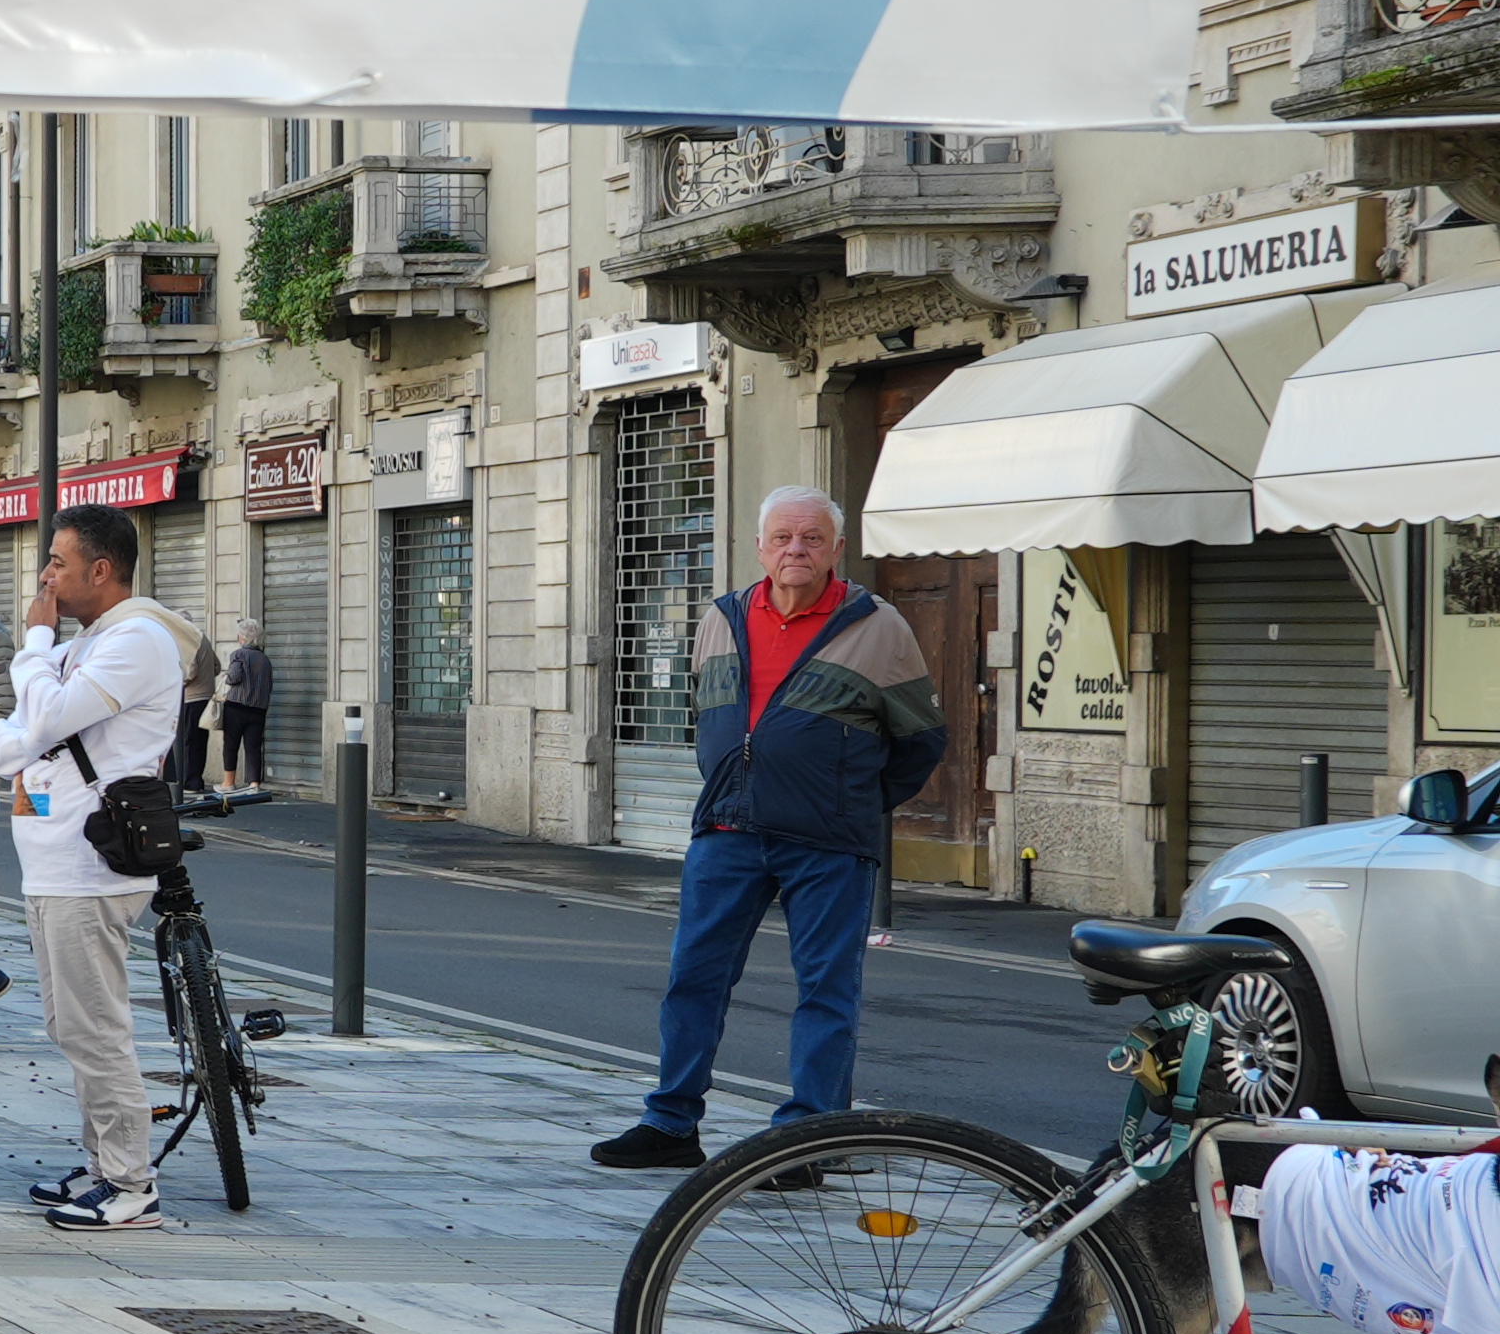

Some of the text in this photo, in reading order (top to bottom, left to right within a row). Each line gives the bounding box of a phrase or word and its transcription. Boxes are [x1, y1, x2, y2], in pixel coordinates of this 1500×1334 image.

[1133, 224, 1348, 297] la SALUMERIA
[60, 474, 145, 509] SALUMERIA
[379, 535, 393, 674] SWAROVSKI
[1081, 698, 1124, 720] calda
